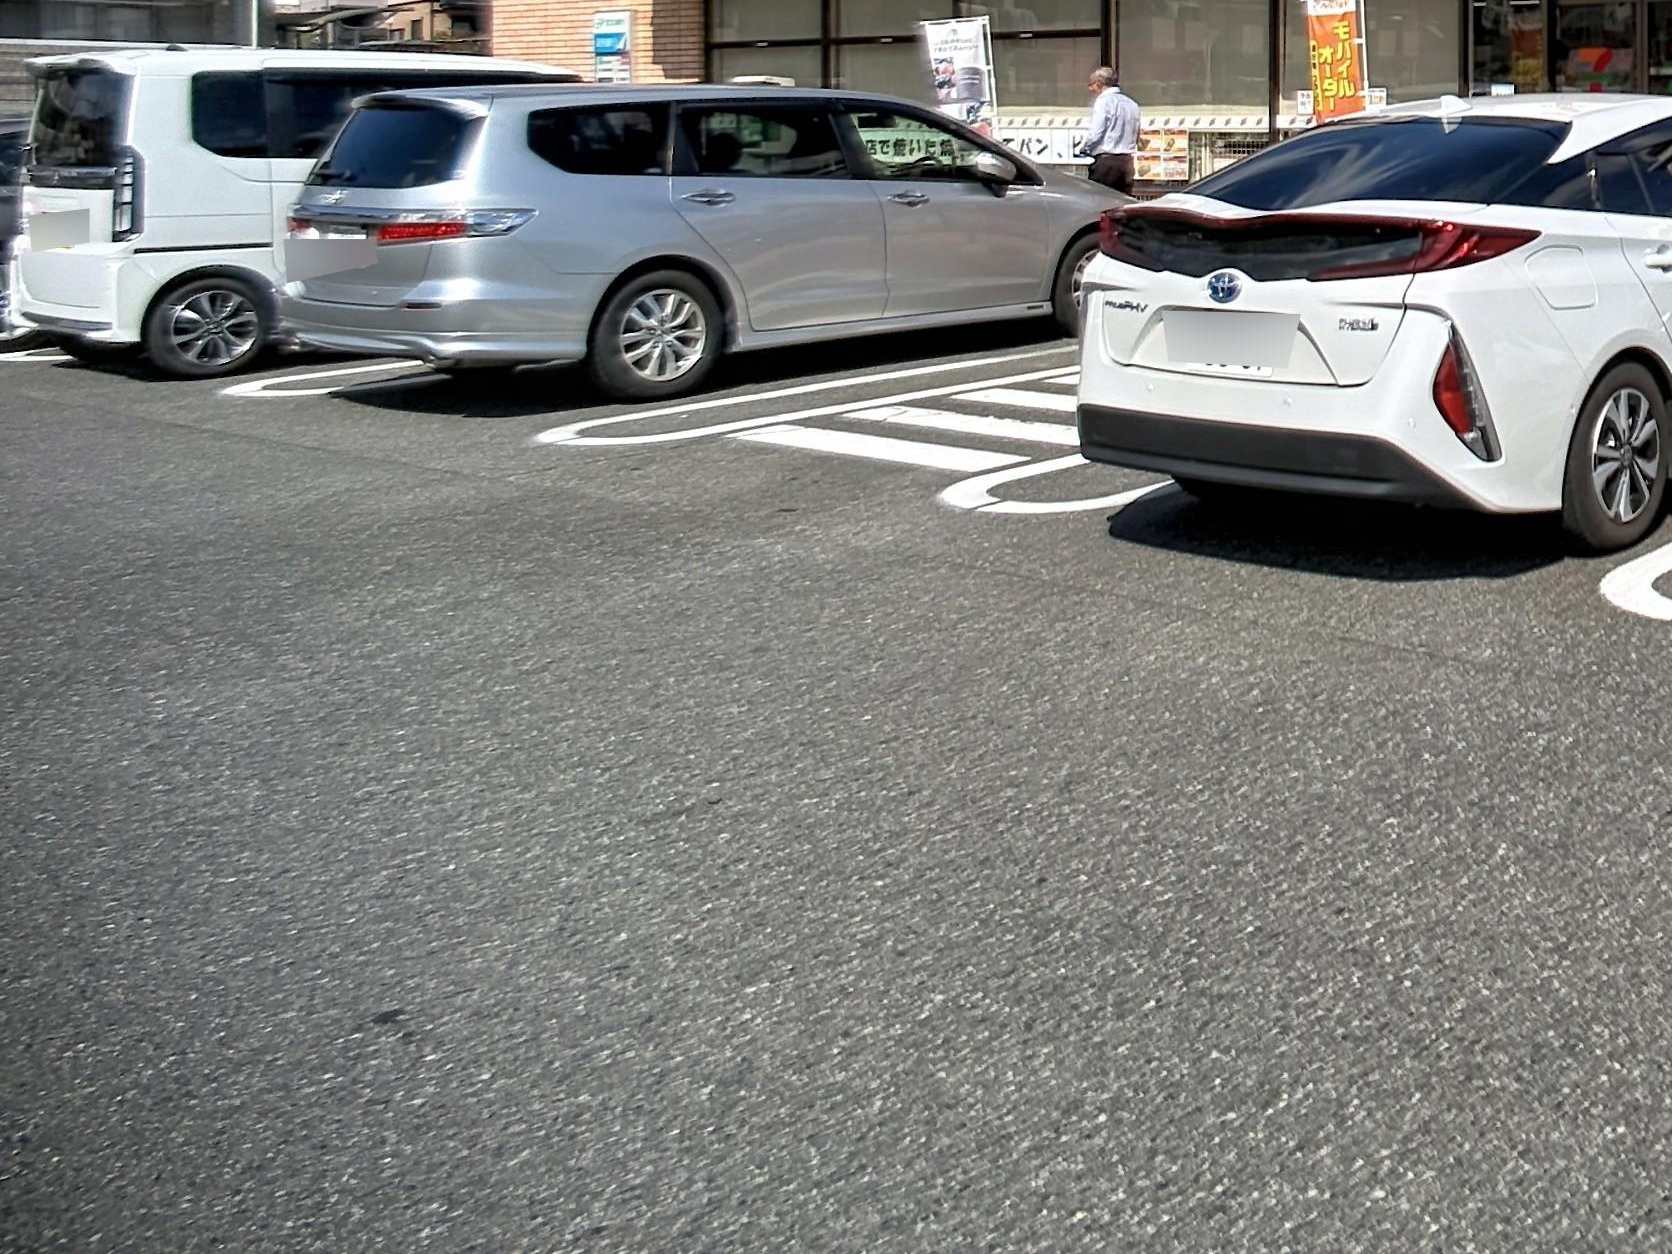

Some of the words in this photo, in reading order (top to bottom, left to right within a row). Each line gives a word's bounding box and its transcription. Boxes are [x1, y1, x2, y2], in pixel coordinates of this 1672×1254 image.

[1318, 45, 1338, 112] オーダー
[1332, 20, 1356, 99] モバイル
